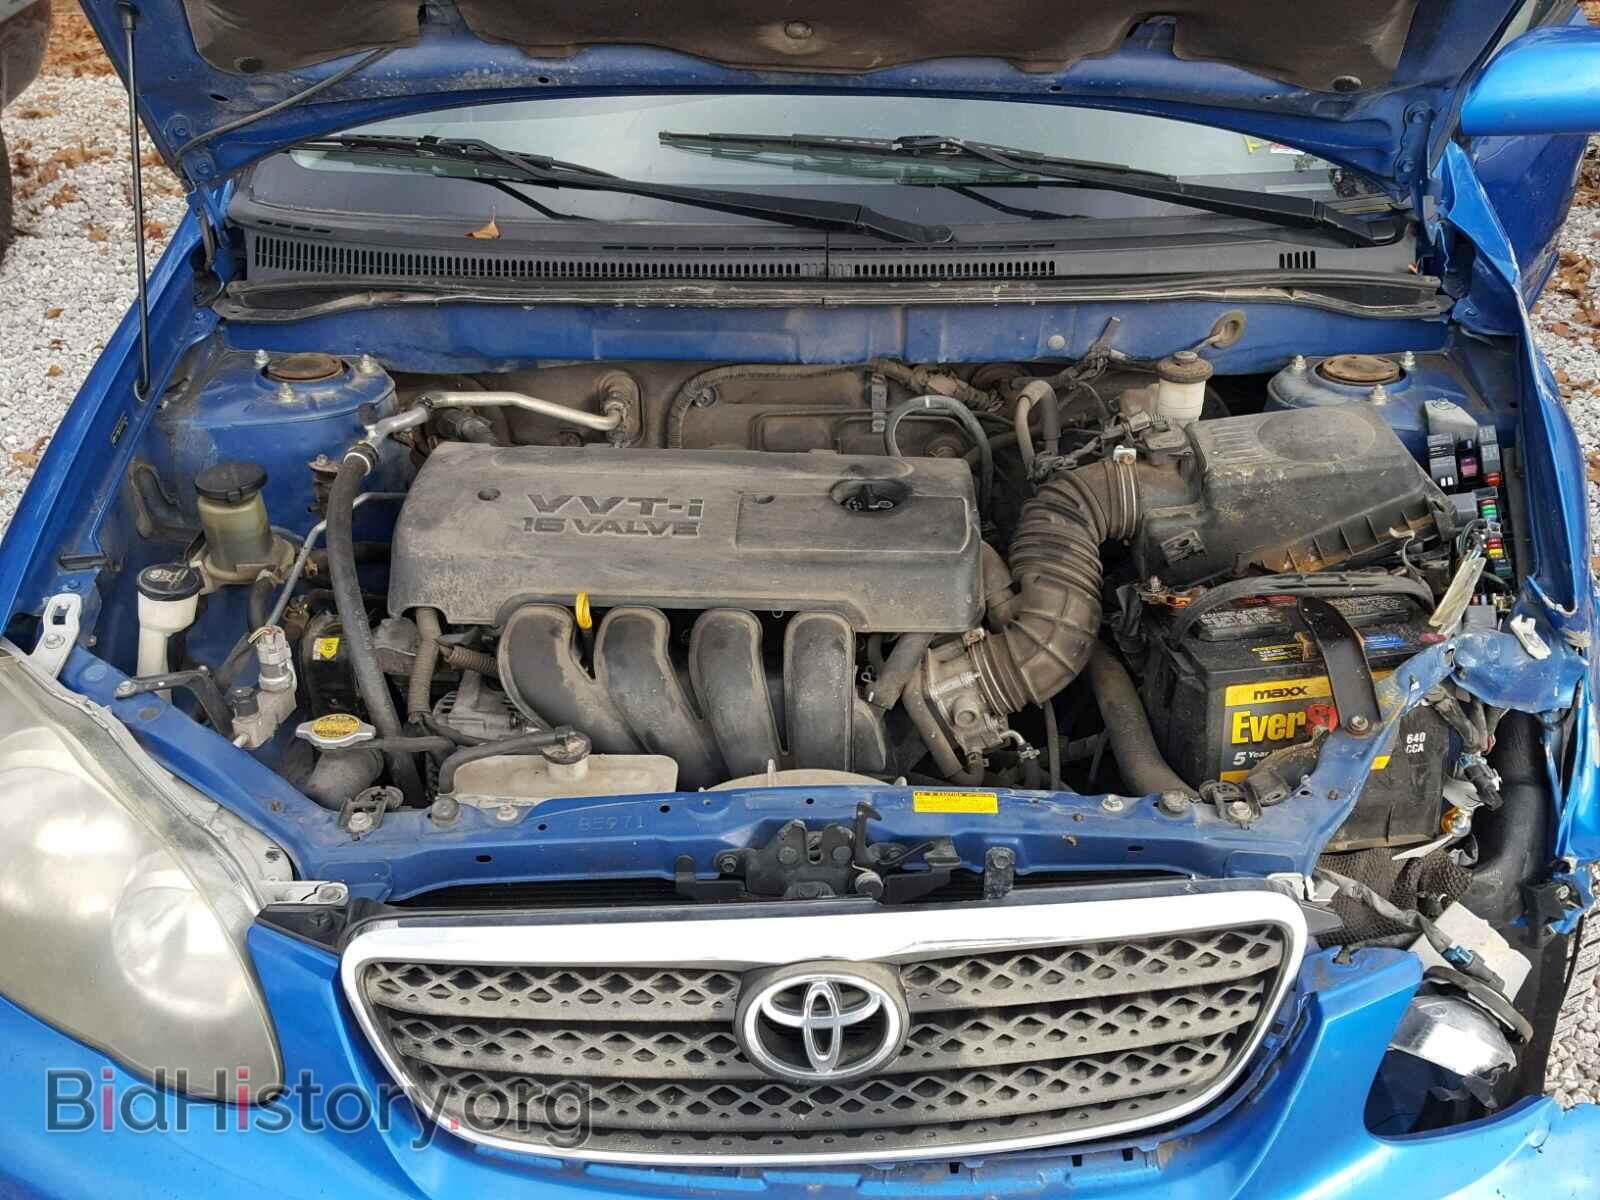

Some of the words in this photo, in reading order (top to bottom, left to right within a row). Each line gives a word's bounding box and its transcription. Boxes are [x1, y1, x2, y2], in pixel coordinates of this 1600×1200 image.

[527, 494, 704, 518] VVT-i
[522, 516, 566, 534] 16
[570, 517, 699, 538] VALVE
[1254, 686, 1308, 700] maxx
[1407, 732, 1426, 744] 640
[1232, 752, 1246, 766] 5
